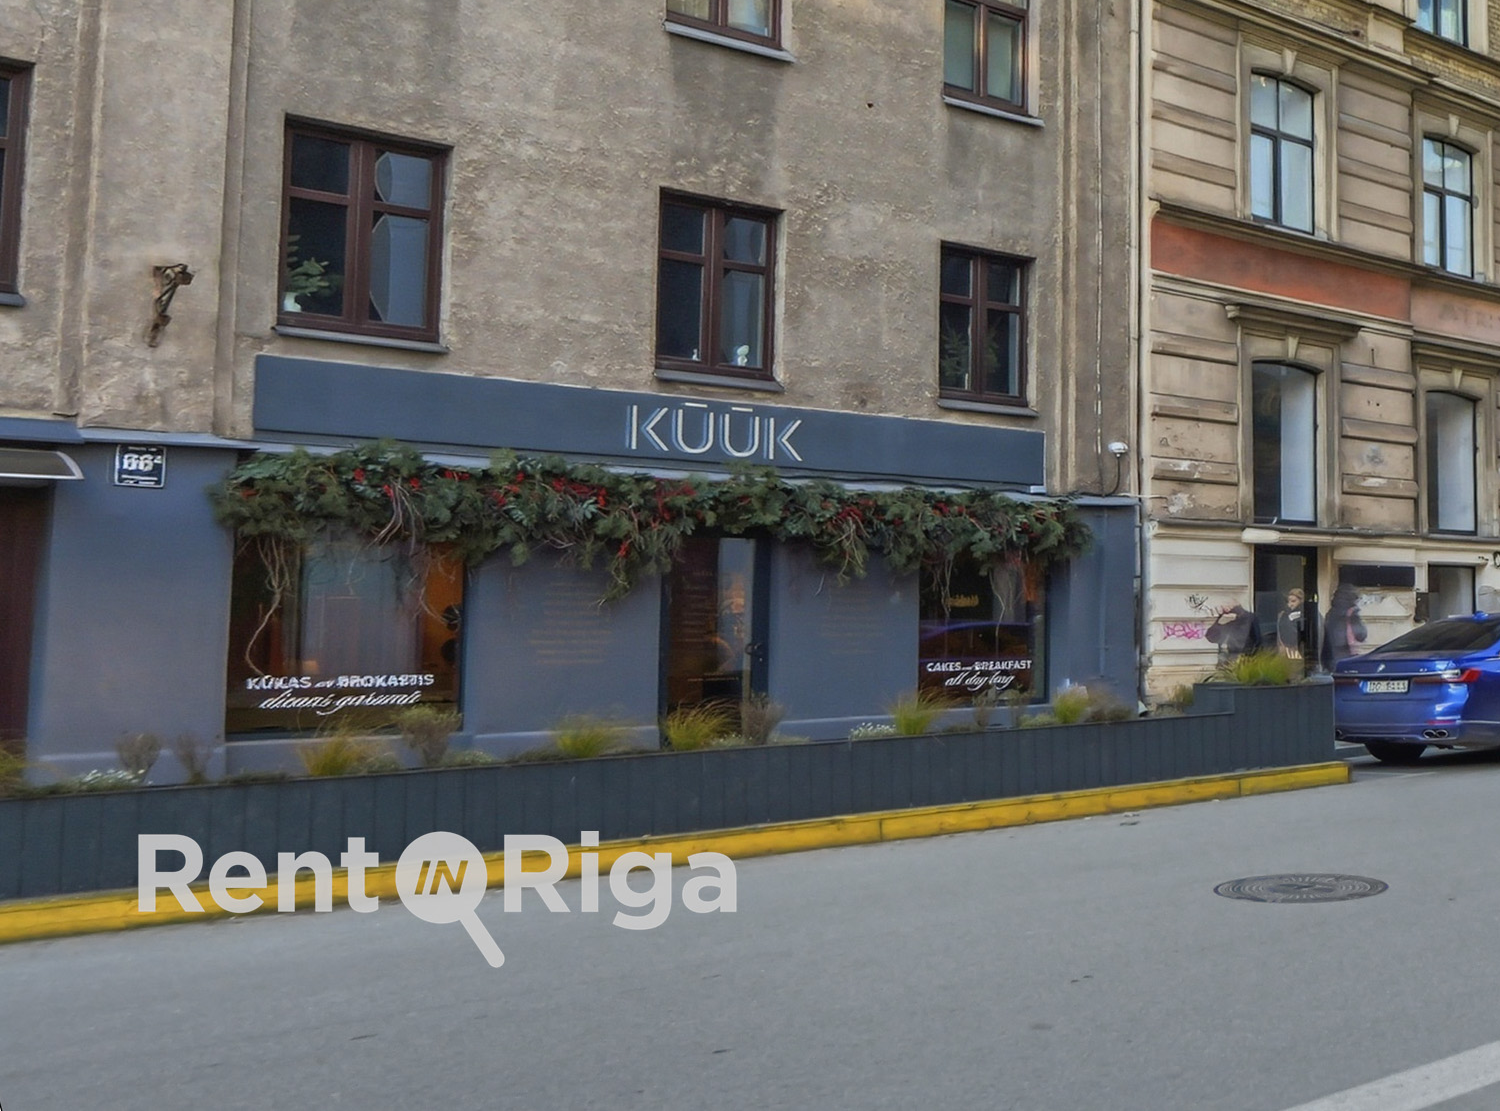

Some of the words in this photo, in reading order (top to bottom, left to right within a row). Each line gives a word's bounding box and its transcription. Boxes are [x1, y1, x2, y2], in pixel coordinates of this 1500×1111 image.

[627, 402, 803, 461] KŪŪK
[926, 662, 962, 672] CAKES
[974, 660, 1033, 671] BREAKFAST
[944, 671, 970, 687] all
[965, 671, 990, 691] day
